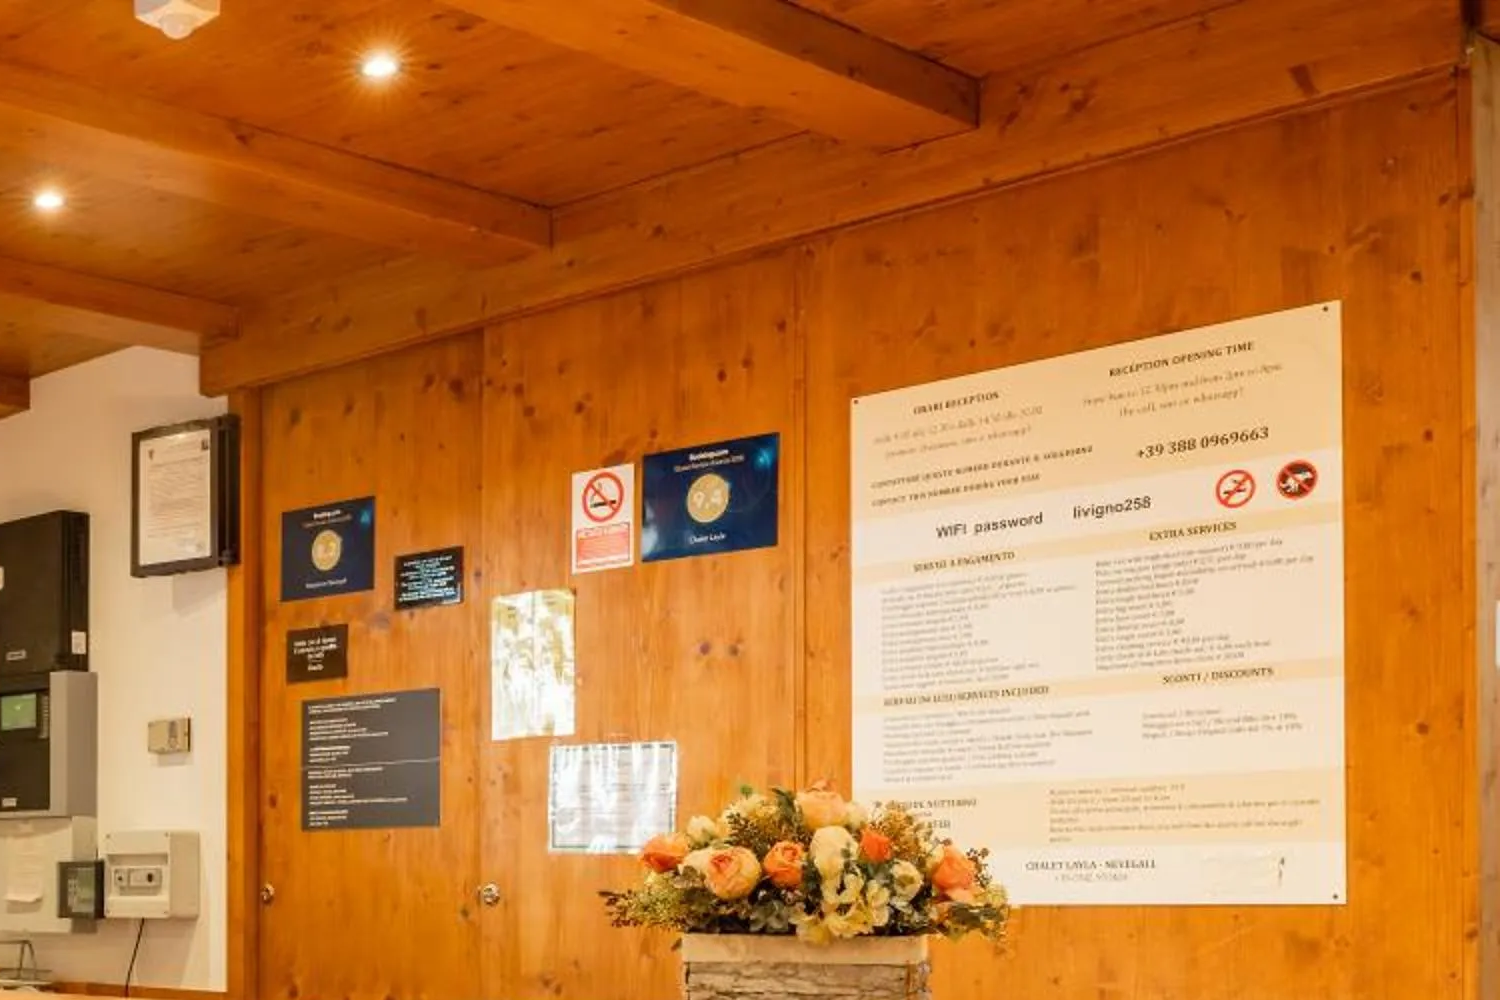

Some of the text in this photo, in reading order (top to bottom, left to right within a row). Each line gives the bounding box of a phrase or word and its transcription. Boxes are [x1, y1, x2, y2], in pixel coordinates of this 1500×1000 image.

[1108, 341, 1253, 377] RECEPTION OPENING TIME
[1136, 427, 1269, 460] +39 388 0969663
[973, 513, 1043, 535] password
[1072, 497, 1151, 521] livigno258
[1148, 521, 1236, 540] EXTRA SERVICES
[1211, 667, 1273, 680] DISCOUNTS
[1024, 862, 1062, 871] CHALET
[1065, 861, 1096, 870] LAYLA
